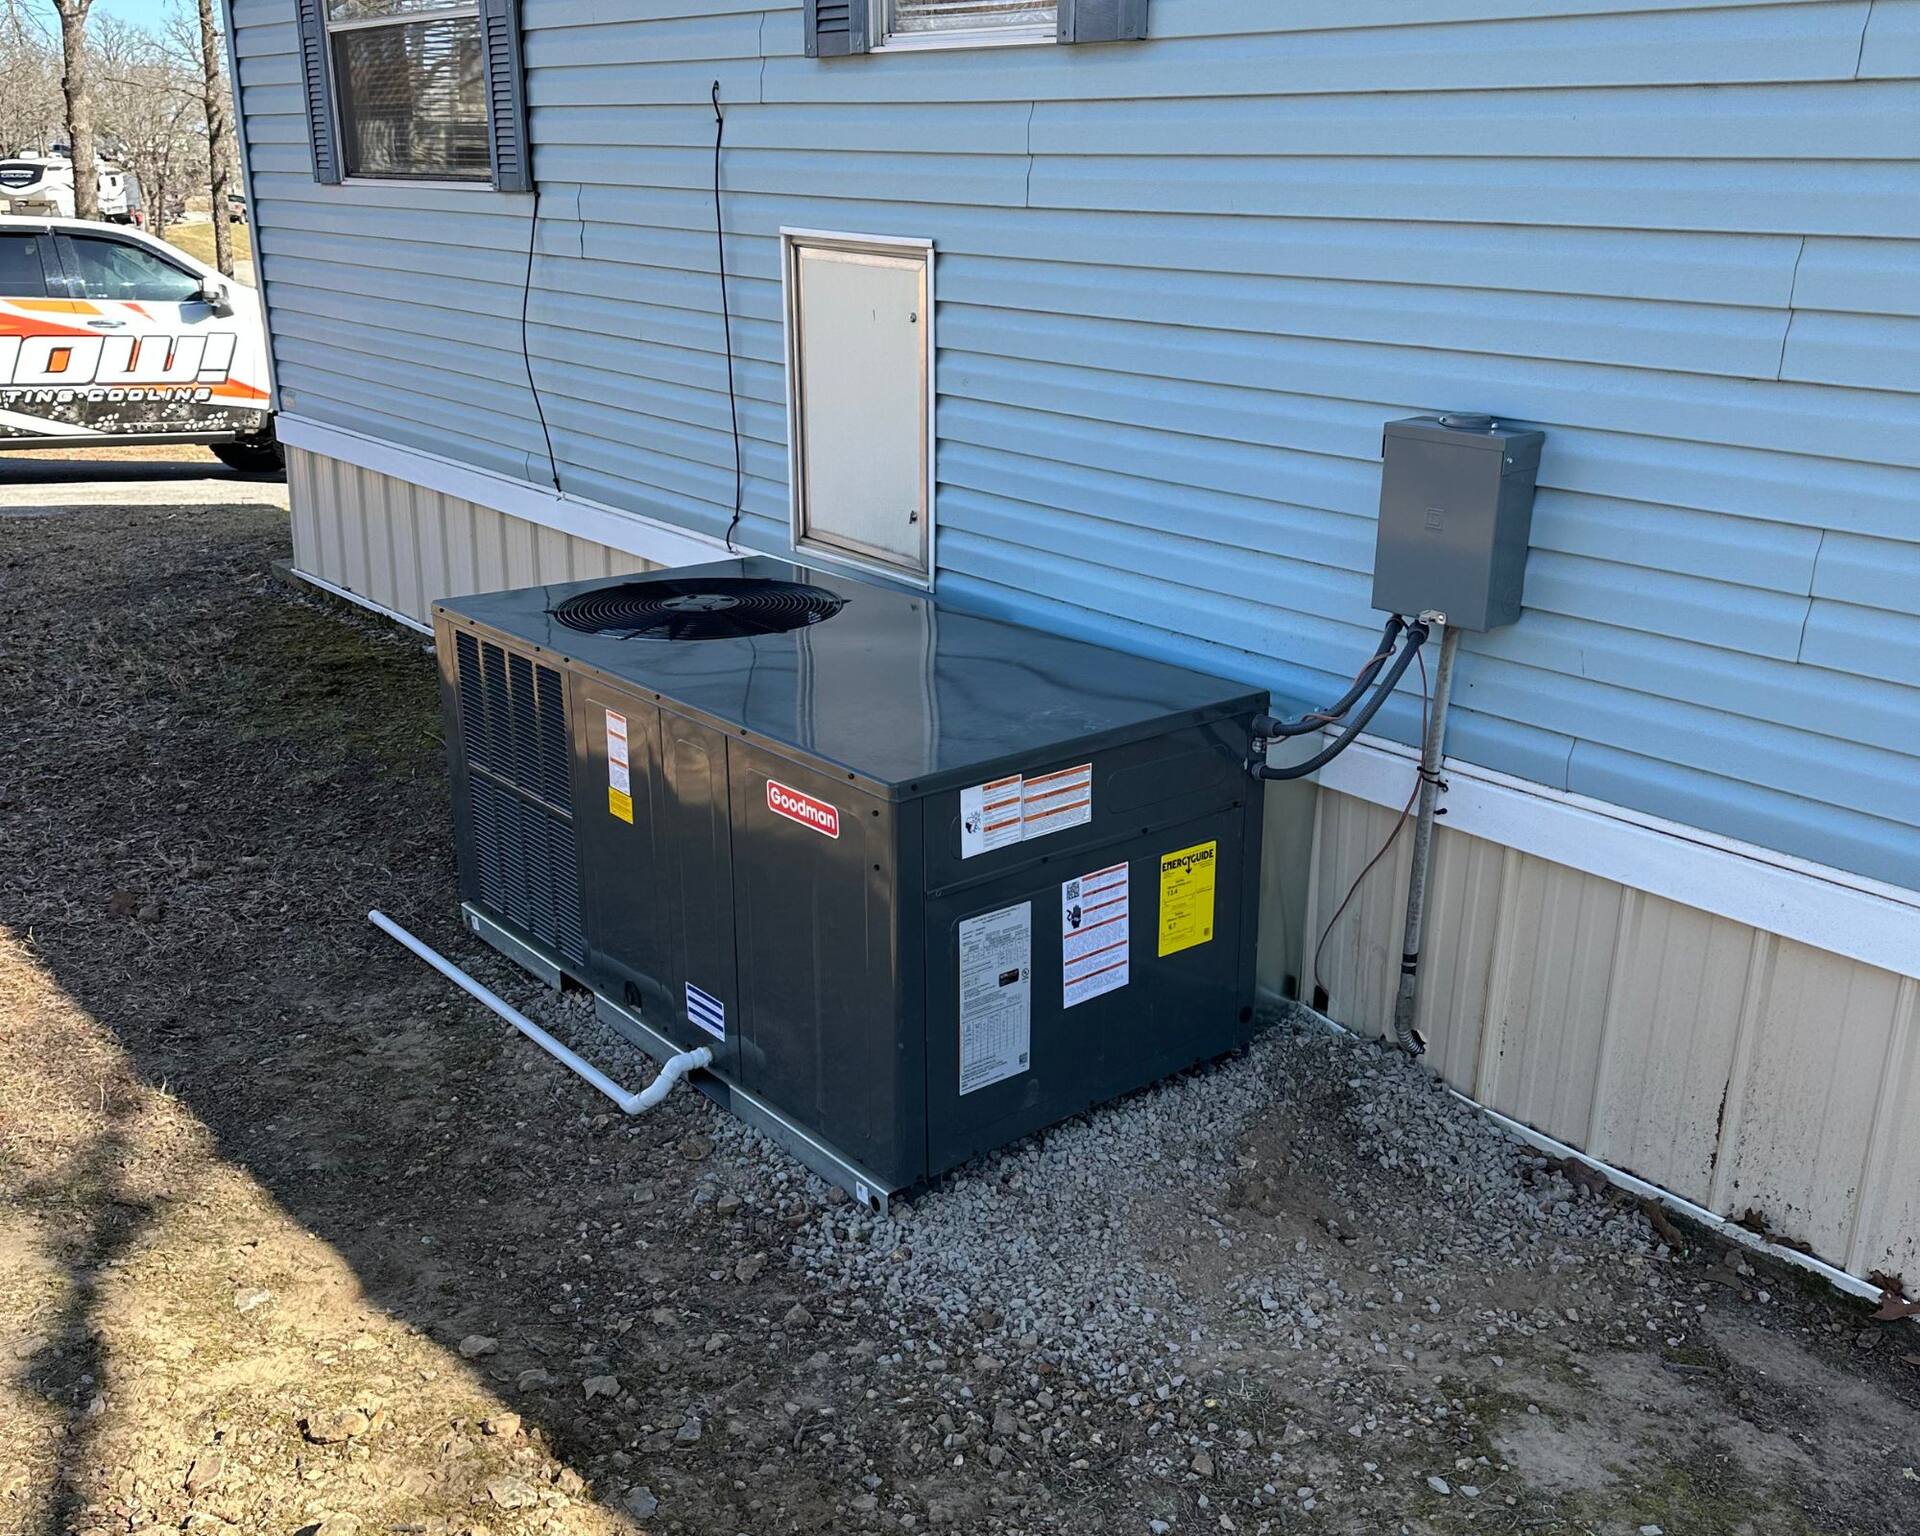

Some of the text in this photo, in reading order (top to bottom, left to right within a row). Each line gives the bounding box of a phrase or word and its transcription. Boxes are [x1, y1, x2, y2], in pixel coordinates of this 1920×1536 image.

[0, 333, 237, 385] OW!
[0, 389, 77, 403] TING
[770, 786, 835, 830] Goodman
